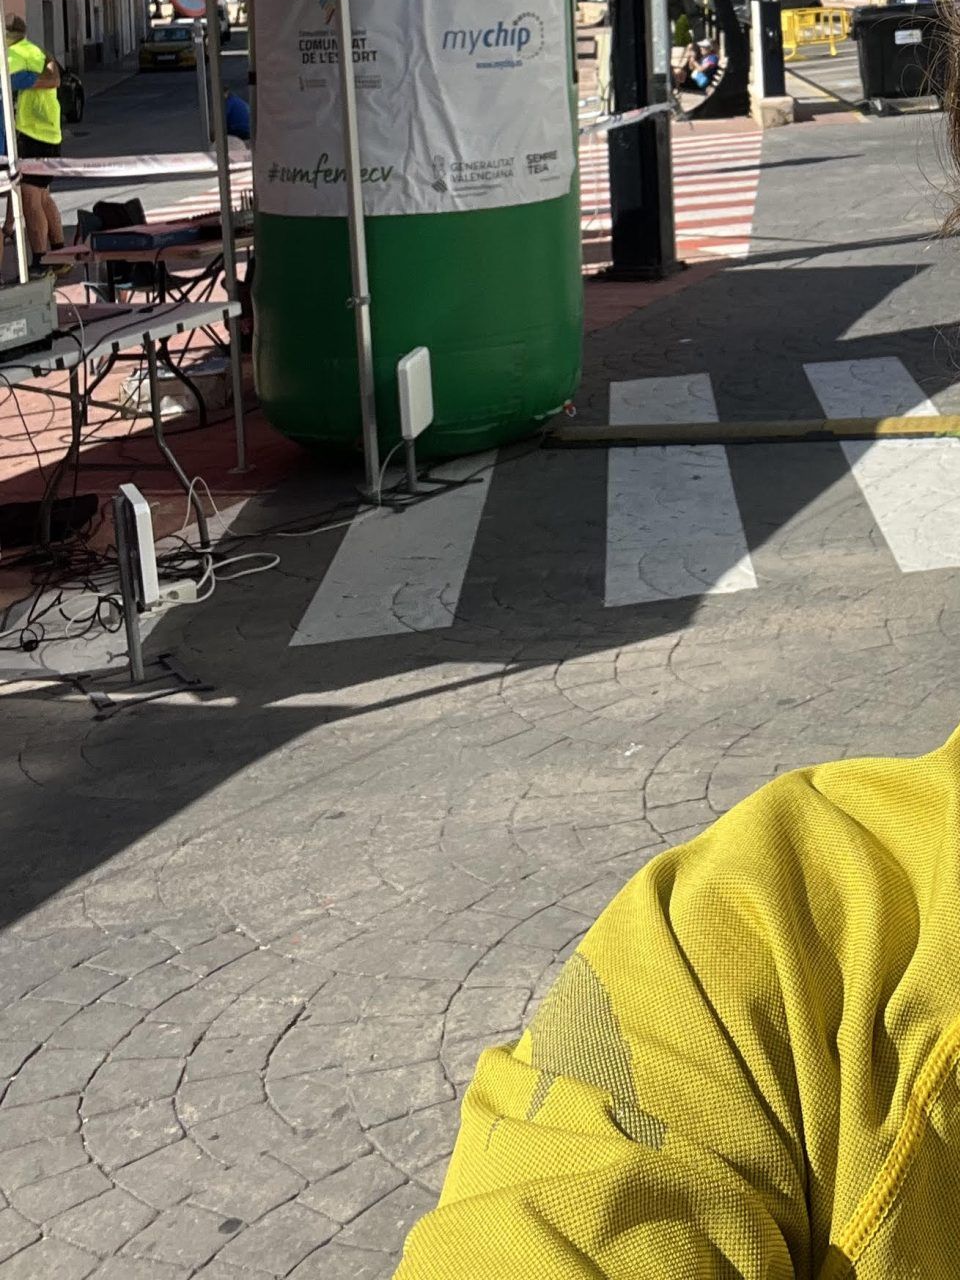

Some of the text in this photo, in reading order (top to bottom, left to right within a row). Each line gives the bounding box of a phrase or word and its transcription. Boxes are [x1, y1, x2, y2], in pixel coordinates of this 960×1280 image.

[299, 37, 367, 51] COMUNAT
[442, 21, 531, 55] mychip
[302, 52, 316, 64] DE
